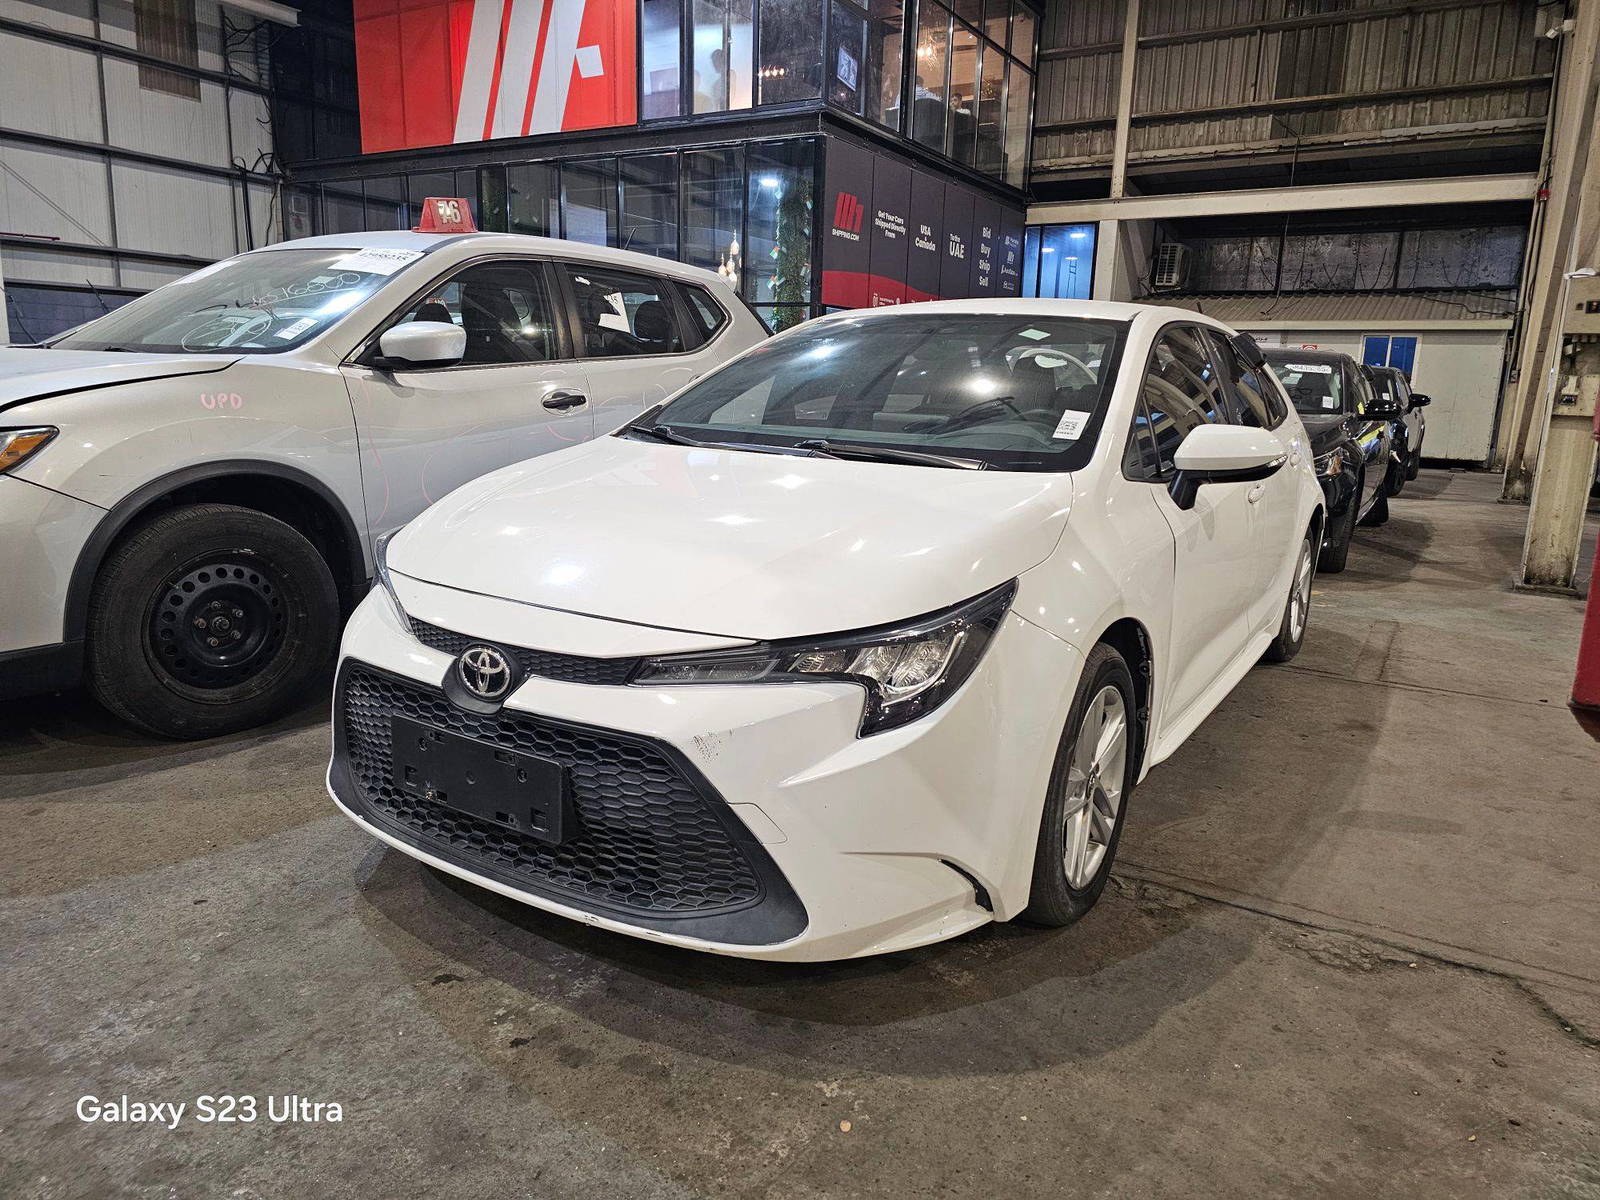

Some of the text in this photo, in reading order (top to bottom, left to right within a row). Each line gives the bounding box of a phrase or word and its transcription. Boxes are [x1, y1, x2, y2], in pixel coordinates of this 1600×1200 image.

[920, 224, 931, 237] USA
[982, 226, 992, 239] Bid
[915, 236, 936, 251] Canada
[949, 240, 965, 259] UAE
[980, 243, 991, 258] Buy
[979, 259, 991, 274] Ship
[979, 275, 989, 287] Sell
